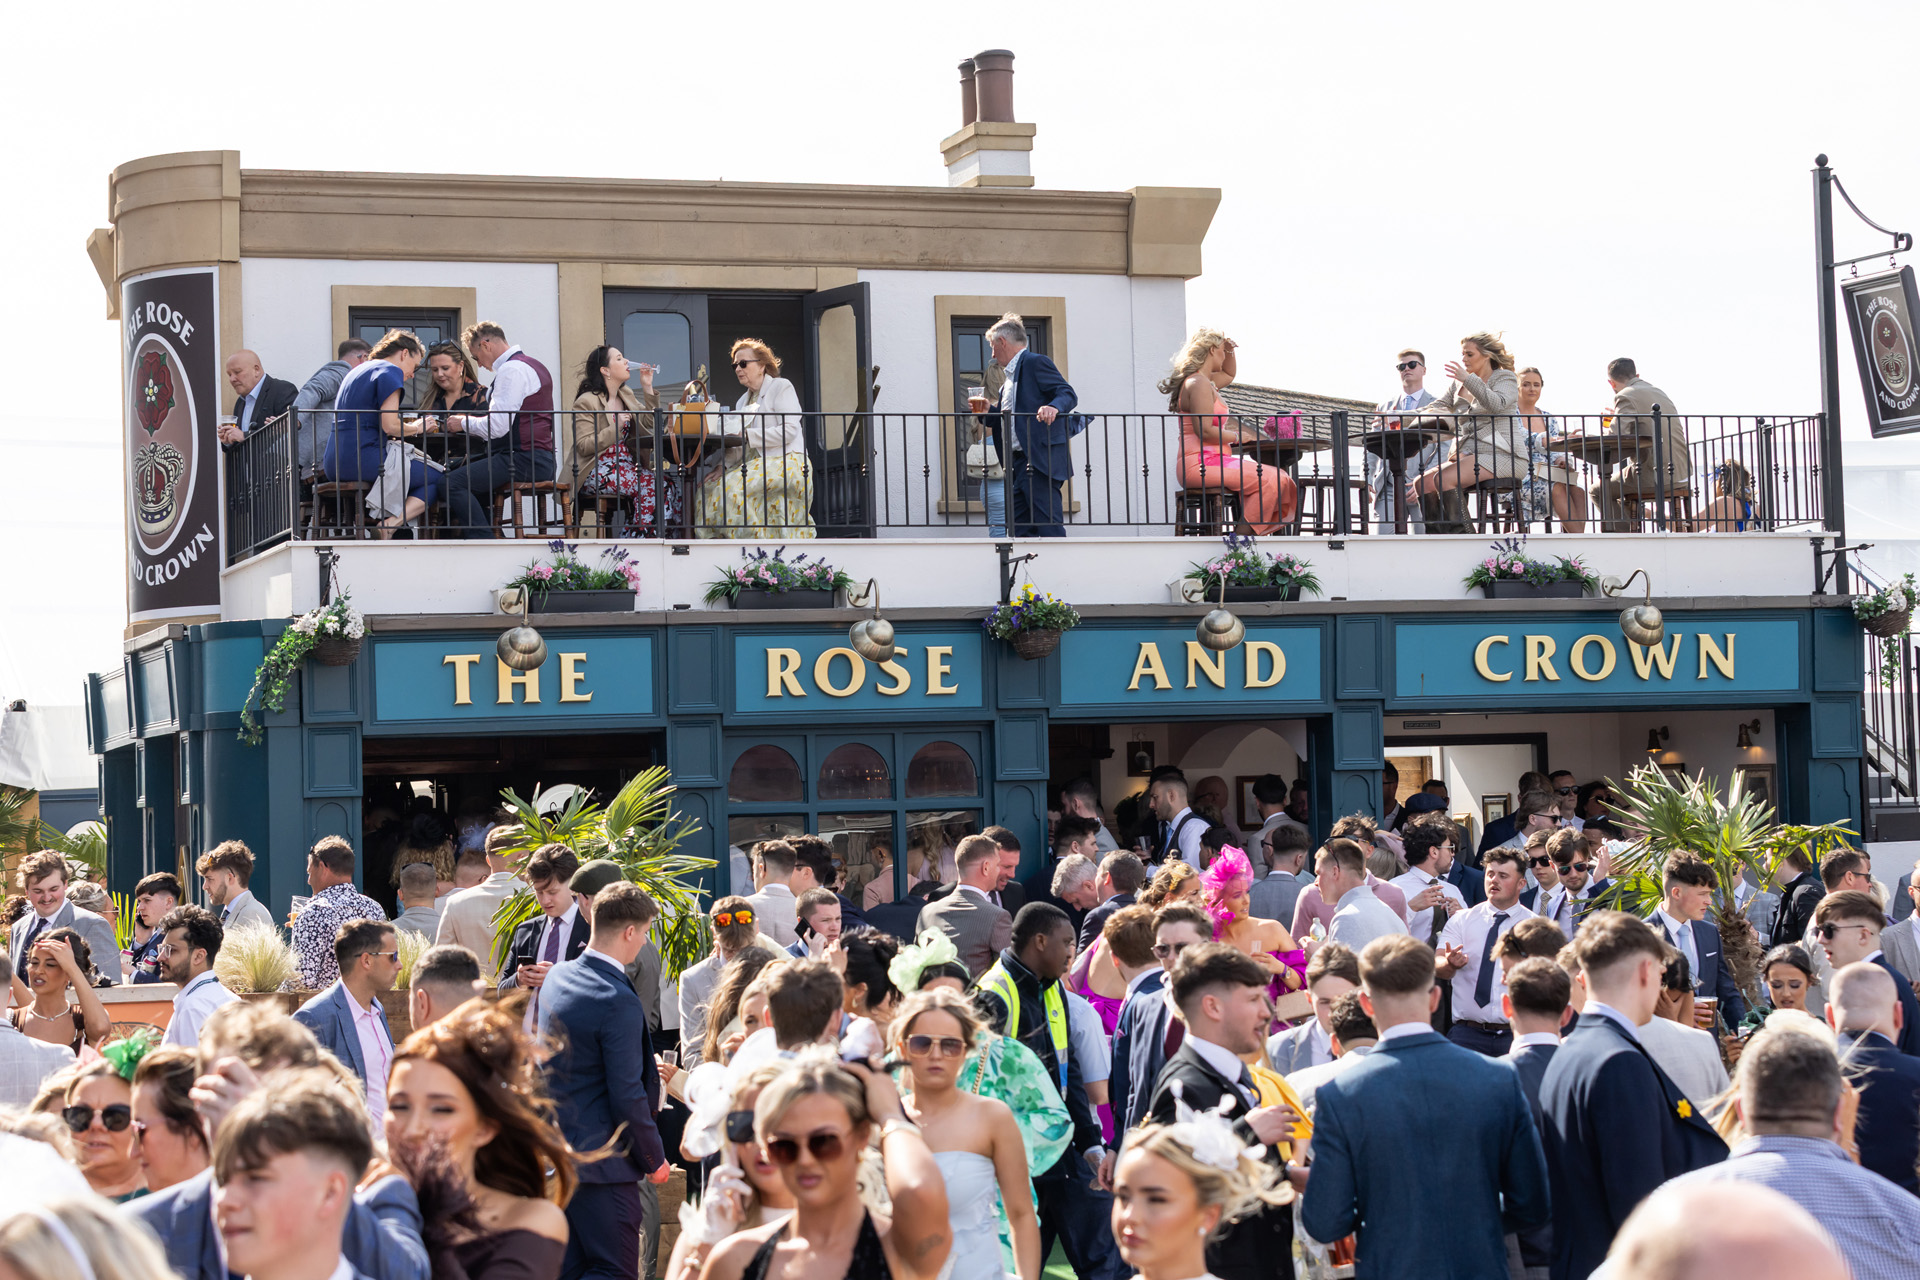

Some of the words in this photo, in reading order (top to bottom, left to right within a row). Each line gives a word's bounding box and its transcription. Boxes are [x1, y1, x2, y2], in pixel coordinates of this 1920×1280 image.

[146, 301, 195, 346] ROSE
[1866, 298, 1878, 318] THE
[1877, 296, 1898, 314] ROSE
[1879, 391, 1896, 408] AND
[1897, 383, 1920, 410] CROWN
[145, 523, 215, 586] CROWN
[442, 652, 594, 705] THE
[765, 646, 959, 697] ROSE
[1127, 640, 1287, 690] AND
[1474, 633, 1737, 681] CROWN
